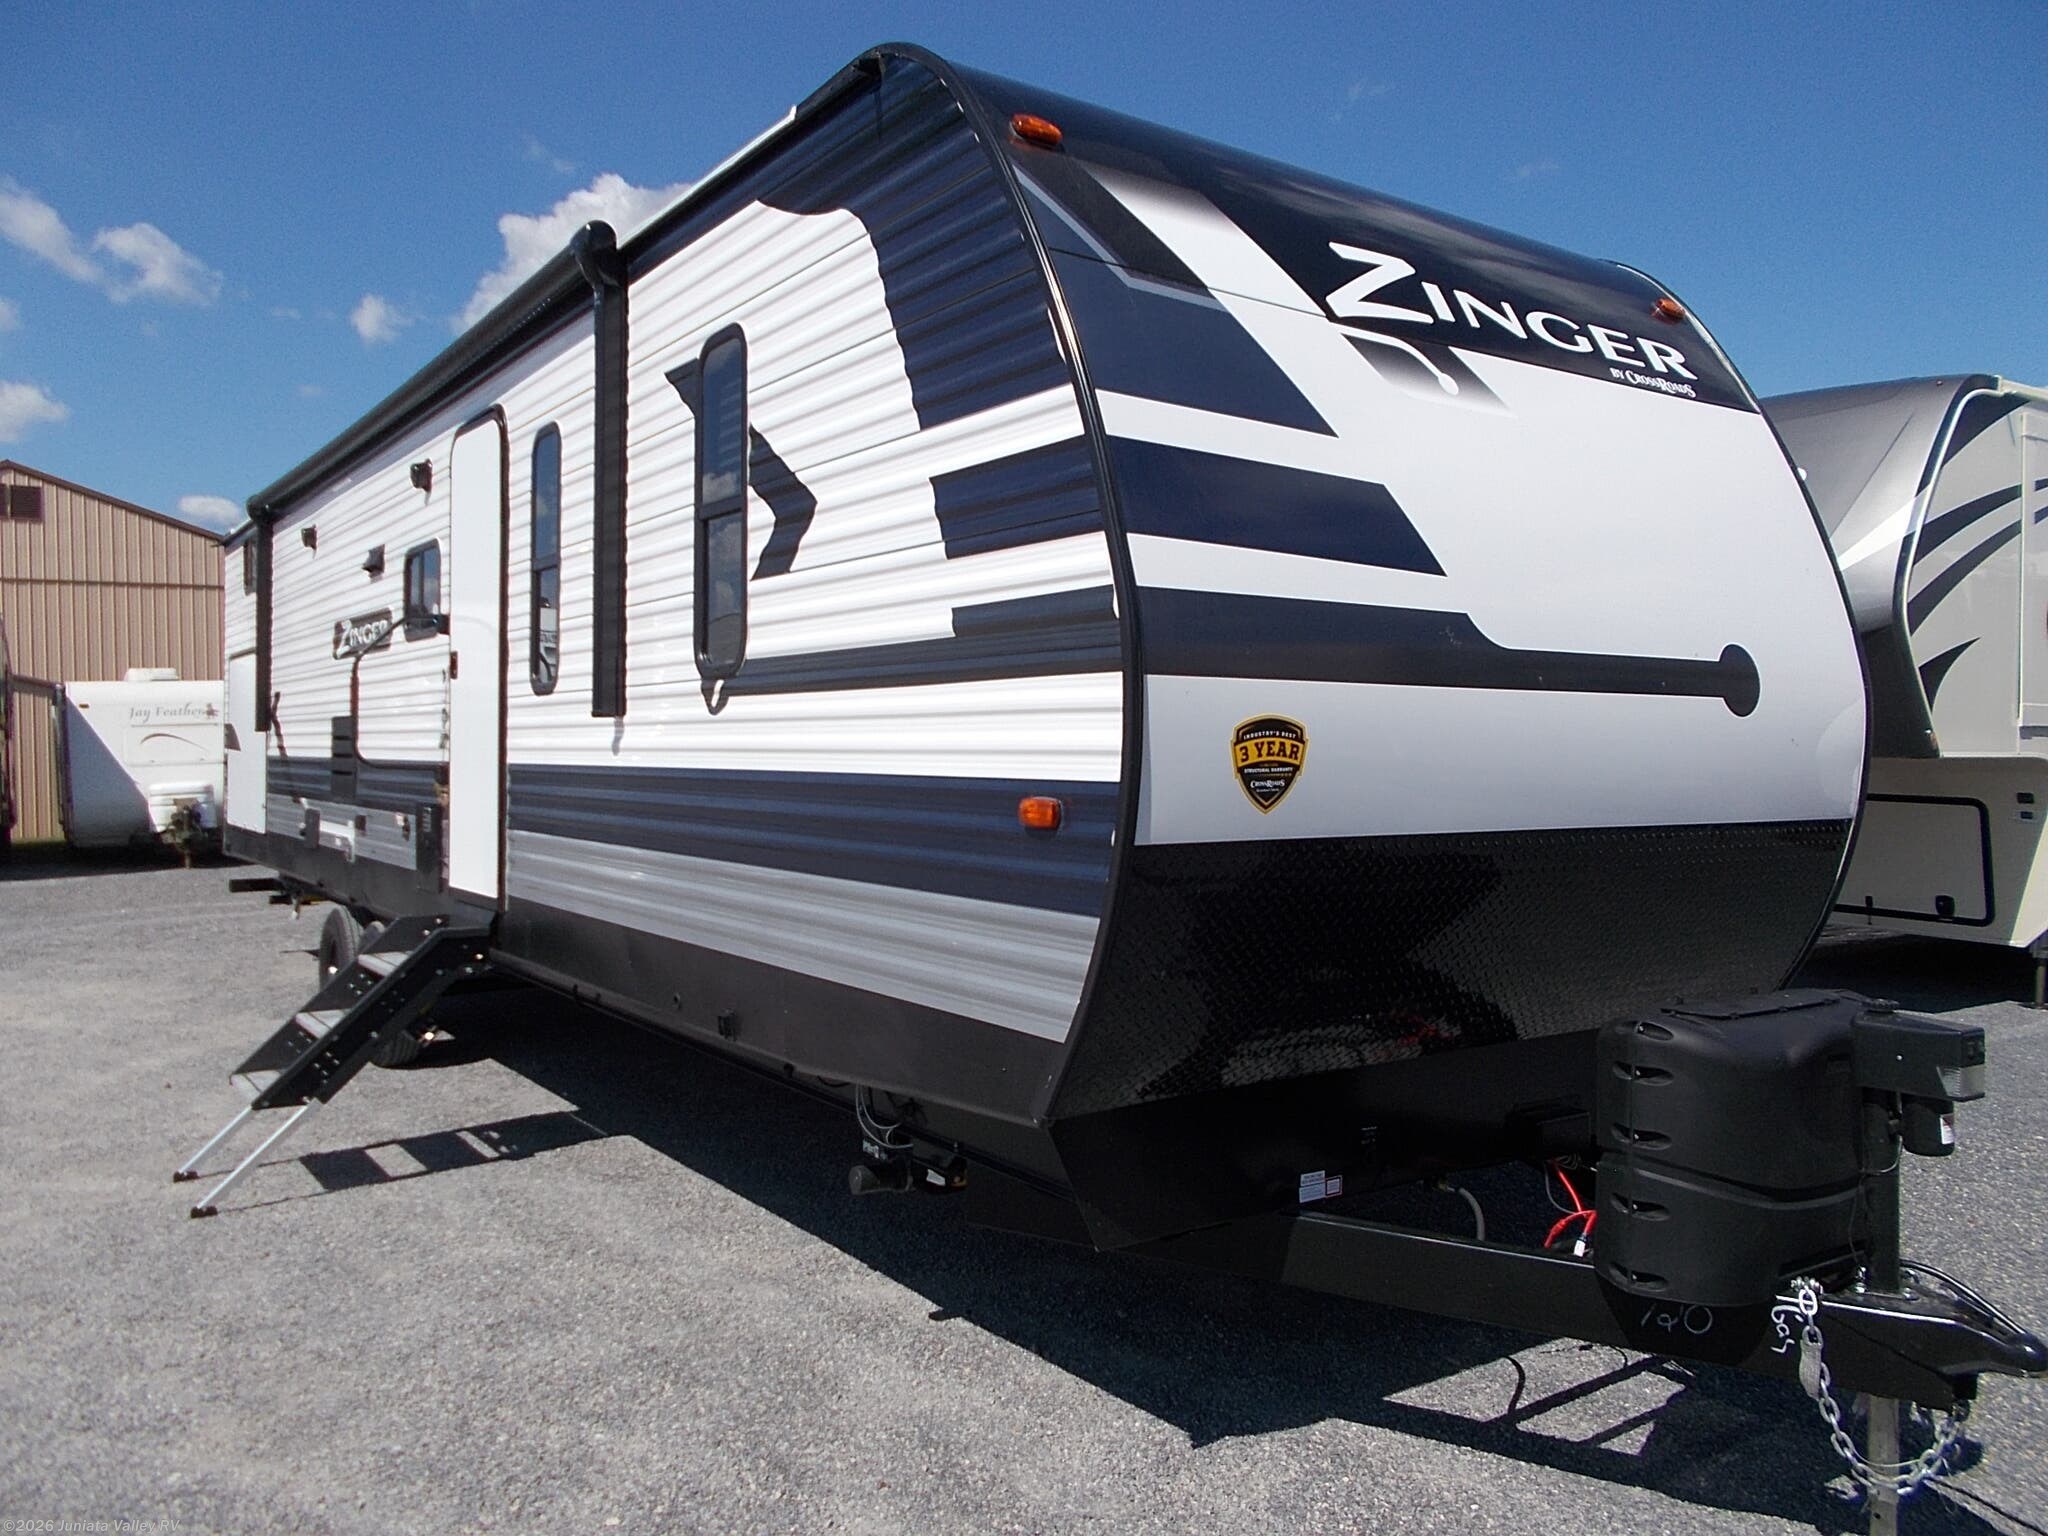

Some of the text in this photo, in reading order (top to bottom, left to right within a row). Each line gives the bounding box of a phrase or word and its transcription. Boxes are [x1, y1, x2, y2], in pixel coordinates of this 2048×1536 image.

[1325, 241, 1699, 380] ZINGER
[1609, 367, 1625, 379] BY
[129, 707, 151, 724] Jay
[1239, 741, 1300, 762] 3 YEAR
